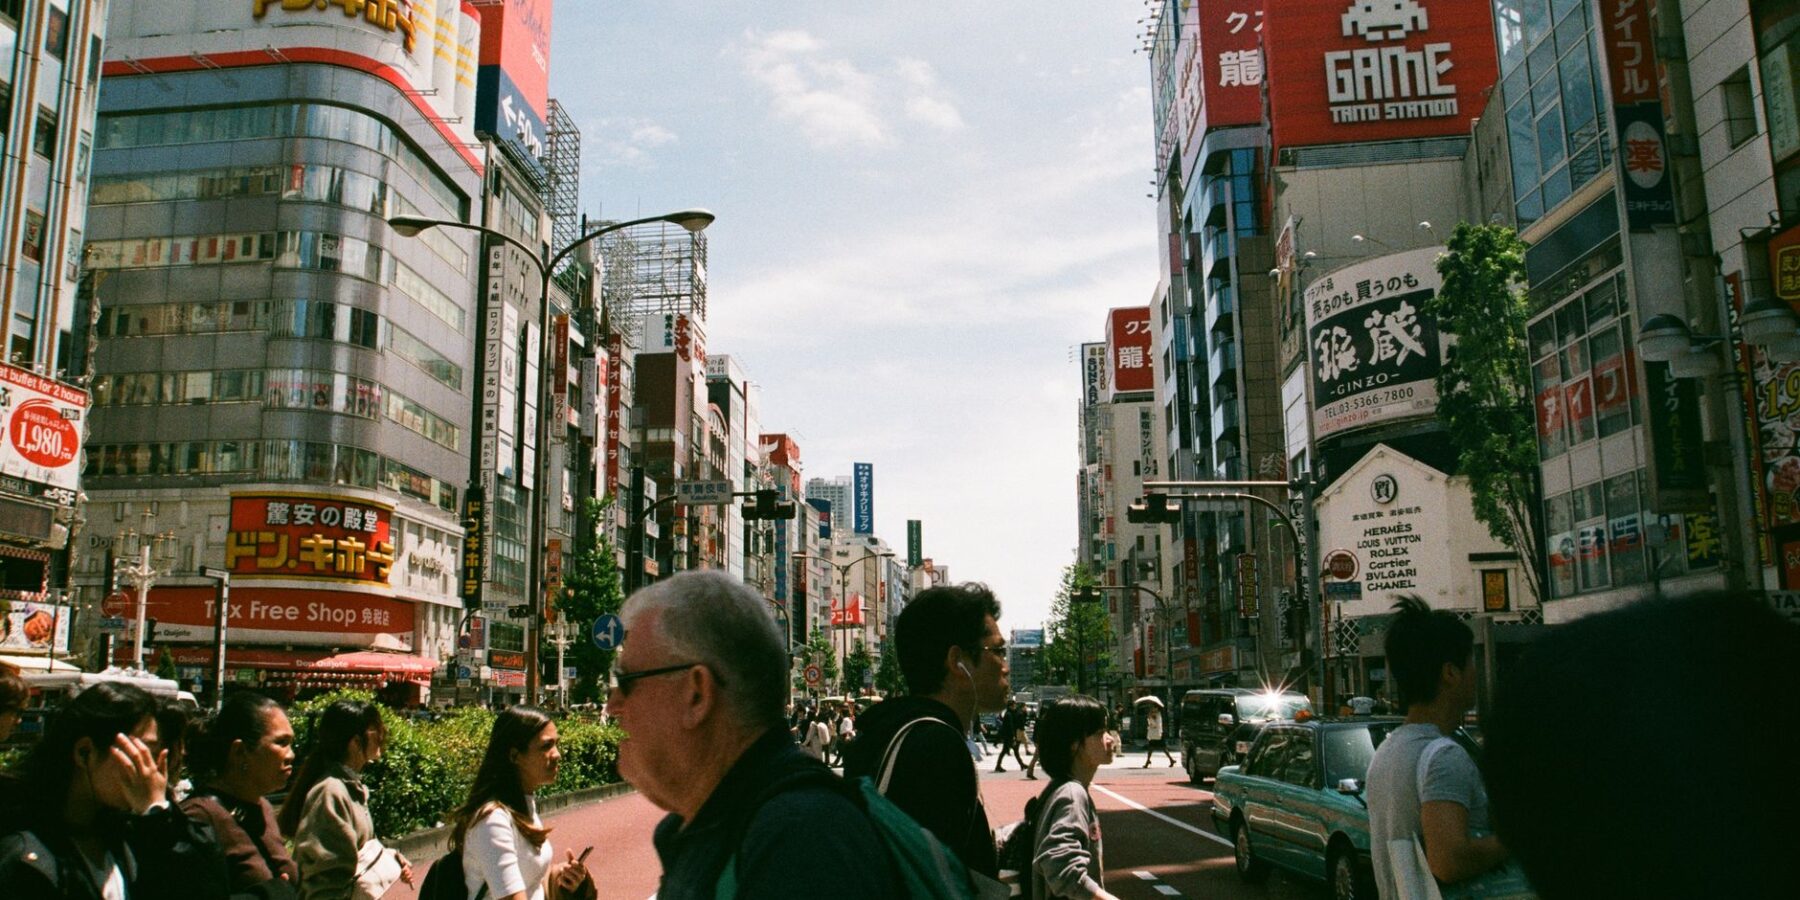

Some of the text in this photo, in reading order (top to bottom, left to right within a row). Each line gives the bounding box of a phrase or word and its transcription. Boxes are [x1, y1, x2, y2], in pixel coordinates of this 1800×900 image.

[1219, 48, 1262, 88] 龍
[1324, 42, 1455, 103] GAME
[1330, 98, 1459, 123] TAITO STATION
[516, 110, 543, 160] 50m
[1626, 139, 1663, 174] 薬
[1312, 272, 1419, 321] 売るのも 買うのも
[9, 368, 37, 387] buffet
[39, 379, 52, 393] for
[53, 385, 60, 396] 2
[61, 387, 86, 405] hours
[607, 343, 621, 459] カラオケ パセラ
[17, 421, 63, 458] 1,980
[266, 502, 379, 532] 驚安の殿堂
[1357, 534, 1422, 549] LOUIS VUITTON
[1370, 546, 1409, 558] ROLEX
[1365, 568, 1417, 581] BVLGARI
[1369, 558, 1412, 570] Cartier
[1367, 580, 1416, 591] CHANEL
[204, 600, 390, 627] Tx Free Shop 免税店
